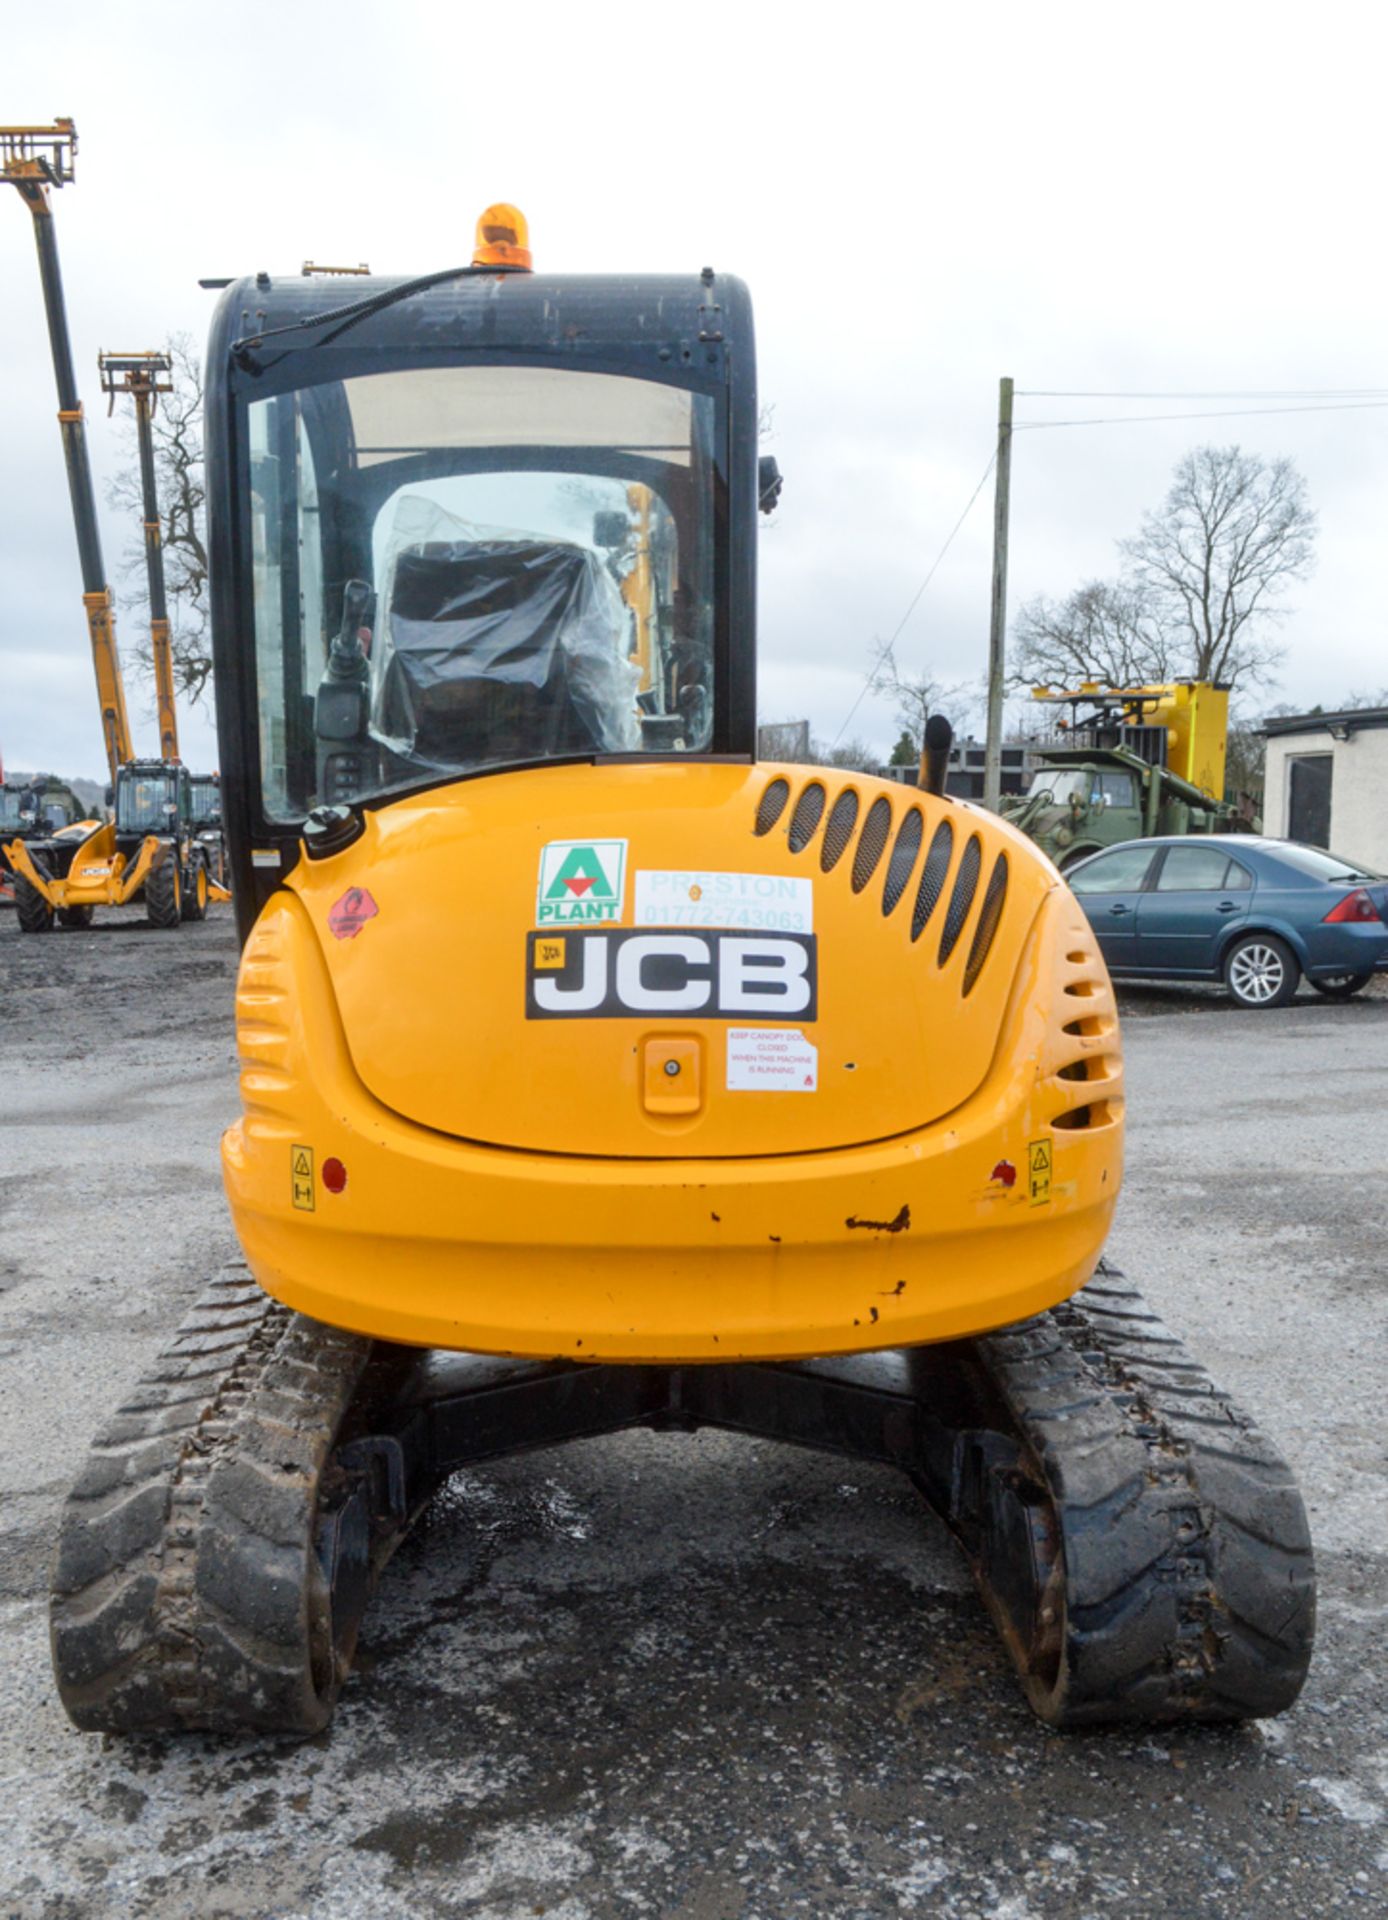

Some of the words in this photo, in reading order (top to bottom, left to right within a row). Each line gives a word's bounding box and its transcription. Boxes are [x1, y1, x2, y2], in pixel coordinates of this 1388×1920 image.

[545, 847, 614, 898] A
[650, 873, 797, 899] PRESTON
[539, 902, 619, 921] PLANT
[533, 935, 811, 1013] JCB
[750, 1032, 784, 1041] CANOPY
[758, 1044, 788, 1052] CLOSED
[731, 1054, 757, 1062] WHEN
[758, 1055, 775, 1063] THIS
[777, 1055, 812, 1064] MACHINE
[757, 1066, 795, 1074] RUNNING
